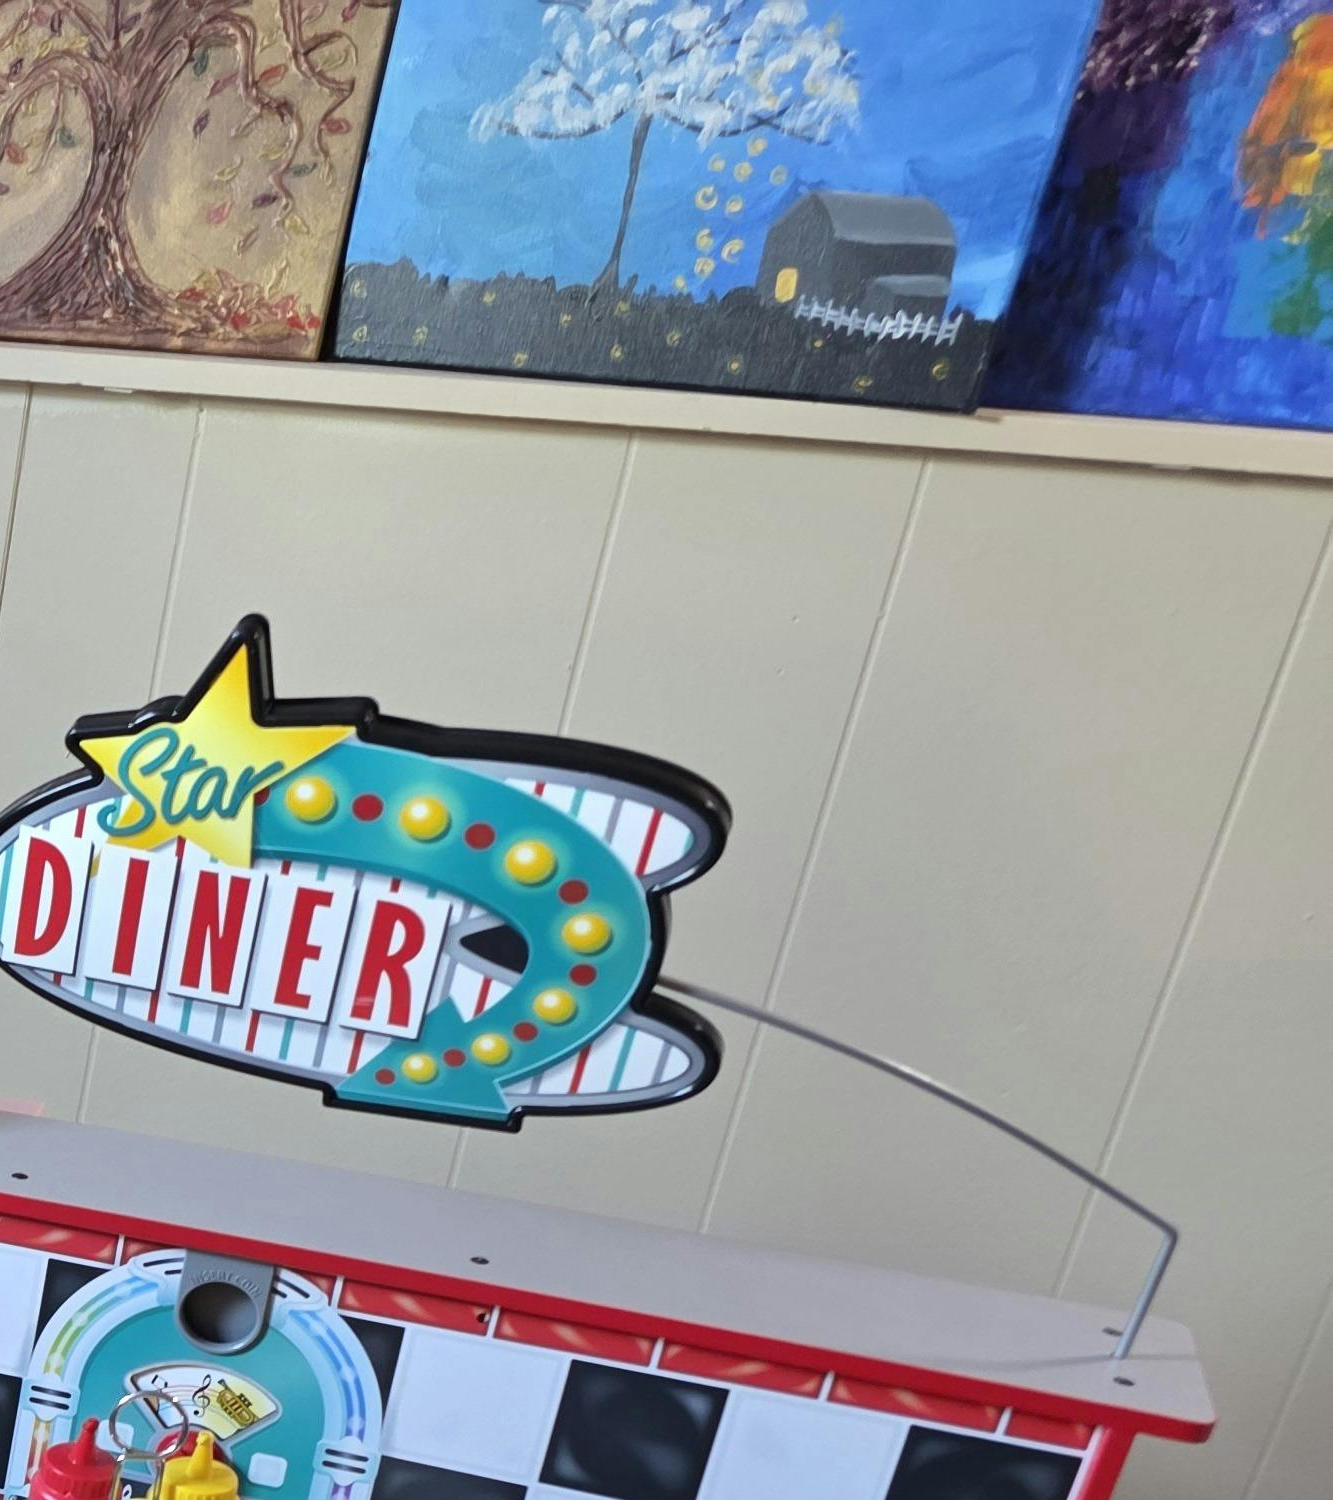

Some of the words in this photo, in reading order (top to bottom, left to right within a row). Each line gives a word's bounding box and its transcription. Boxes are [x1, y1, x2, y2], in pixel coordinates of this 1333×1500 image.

[97, 728, 284, 837] Star
[14, 838, 426, 1027] DINER
[236, 1276, 262, 1298] COIN
